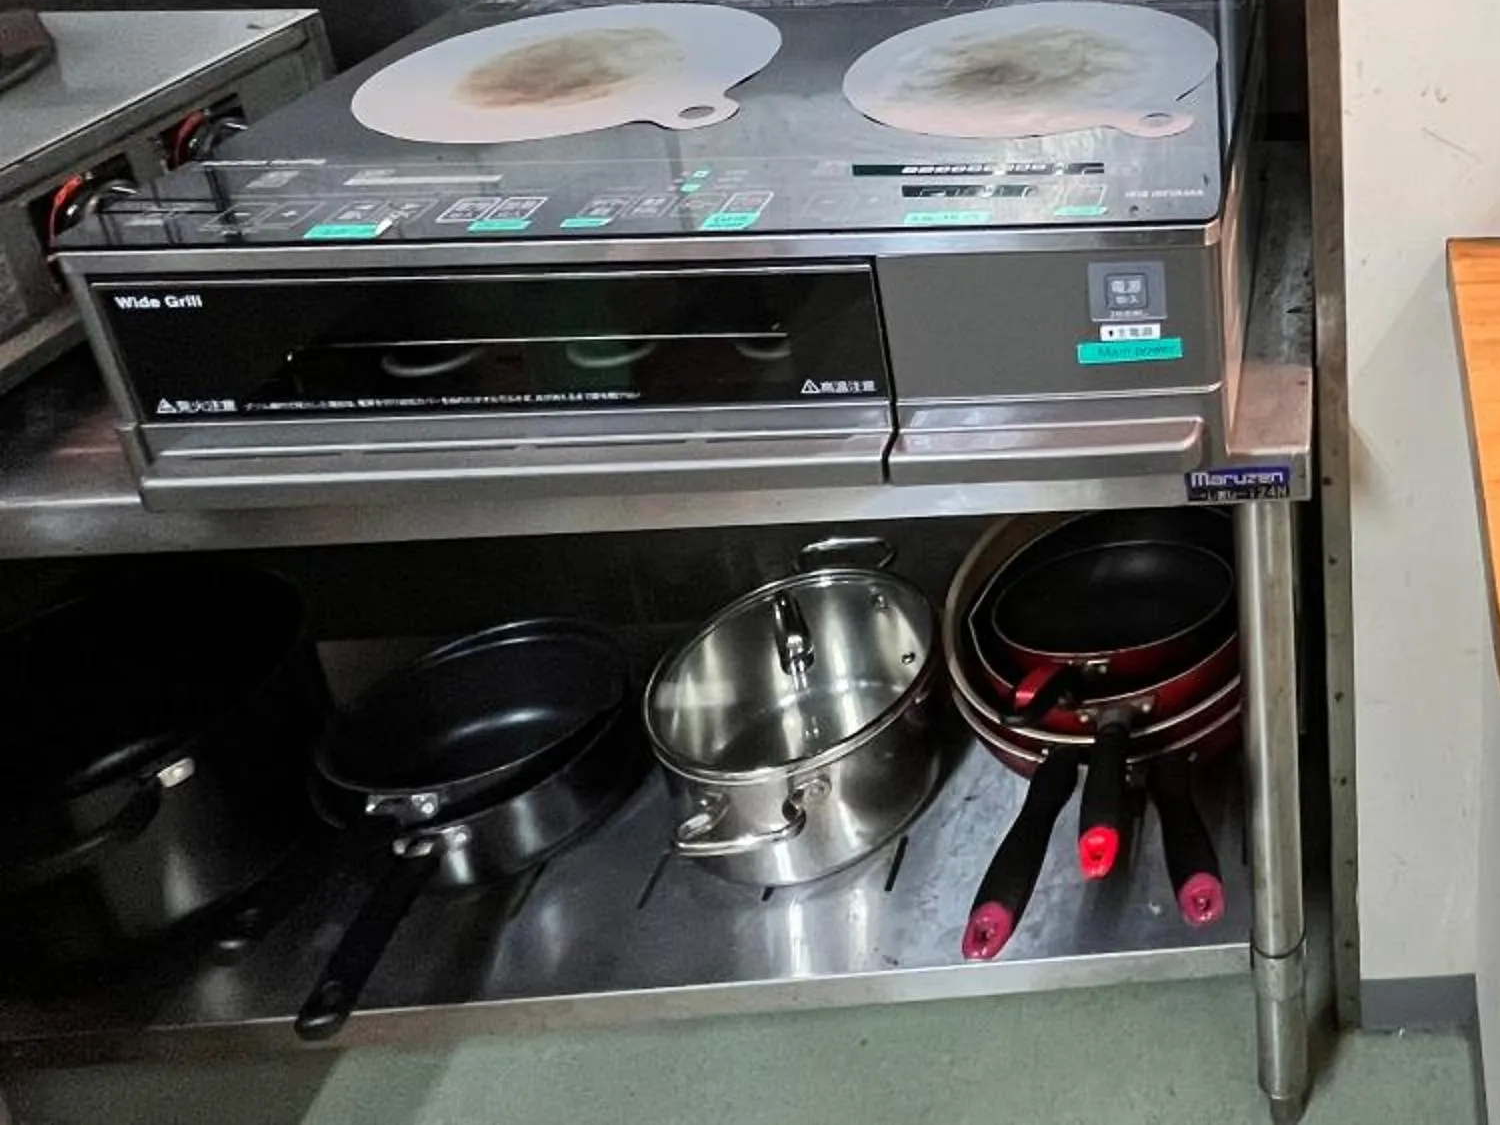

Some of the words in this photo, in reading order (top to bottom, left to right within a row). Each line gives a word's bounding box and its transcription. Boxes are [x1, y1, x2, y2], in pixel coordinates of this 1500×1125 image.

[114, 296, 161, 310] Wide
[163, 294, 204, 309] Grill
[1191, 472, 1284, 488] Maruzen
